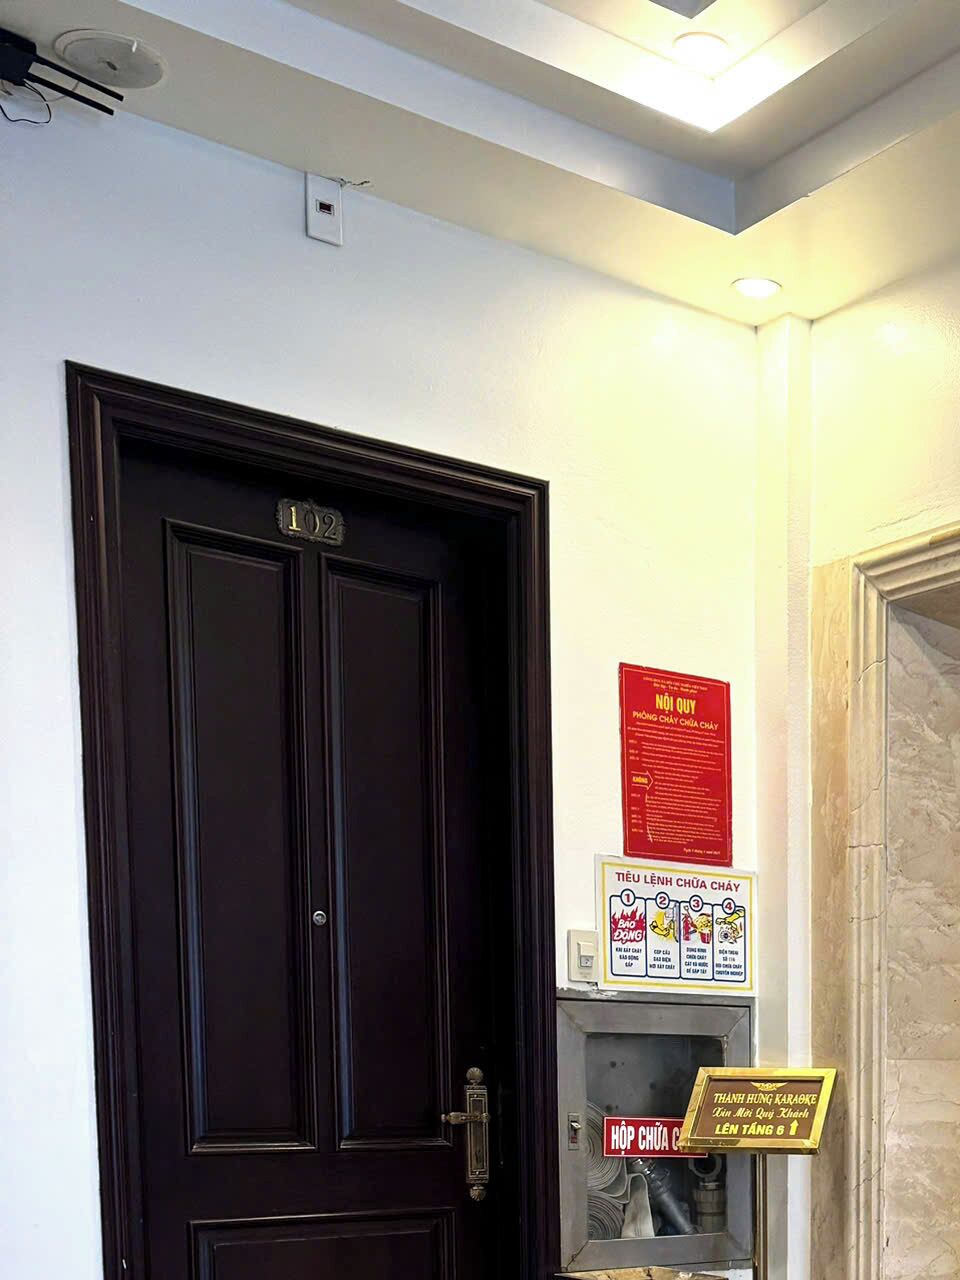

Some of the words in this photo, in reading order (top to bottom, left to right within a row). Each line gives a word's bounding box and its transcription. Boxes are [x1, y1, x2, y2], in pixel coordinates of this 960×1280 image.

[287, 505, 338, 539] 102
[655, 692, 673, 714] NỘI
[676, 697, 696, 715] QUY
[615, 870, 640, 883] TIÊU
[644, 873, 673, 887] LỆNH
[675, 875, 707, 890] CHỮA
[710, 879, 740, 893] CHÁY
[624, 893, 631, 903] 1
[659, 896, 666, 905] 2
[692, 899, 700, 908] 3
[724, 901, 733, 911] 4
[617, 918, 636, 929] BÁO
[774, 1093, 818, 1106] KARAOKE
[712, 1107, 731, 1118] Xin
[733, 1108, 752, 1118] Mời
[777, 1107, 810, 1119] Khách
[611, 1120, 635, 1155] HỘP
[638, 1121, 669, 1151] CHỮA
[714, 1122, 739, 1135] LÊN
[776, 1125, 785, 1136] 6
